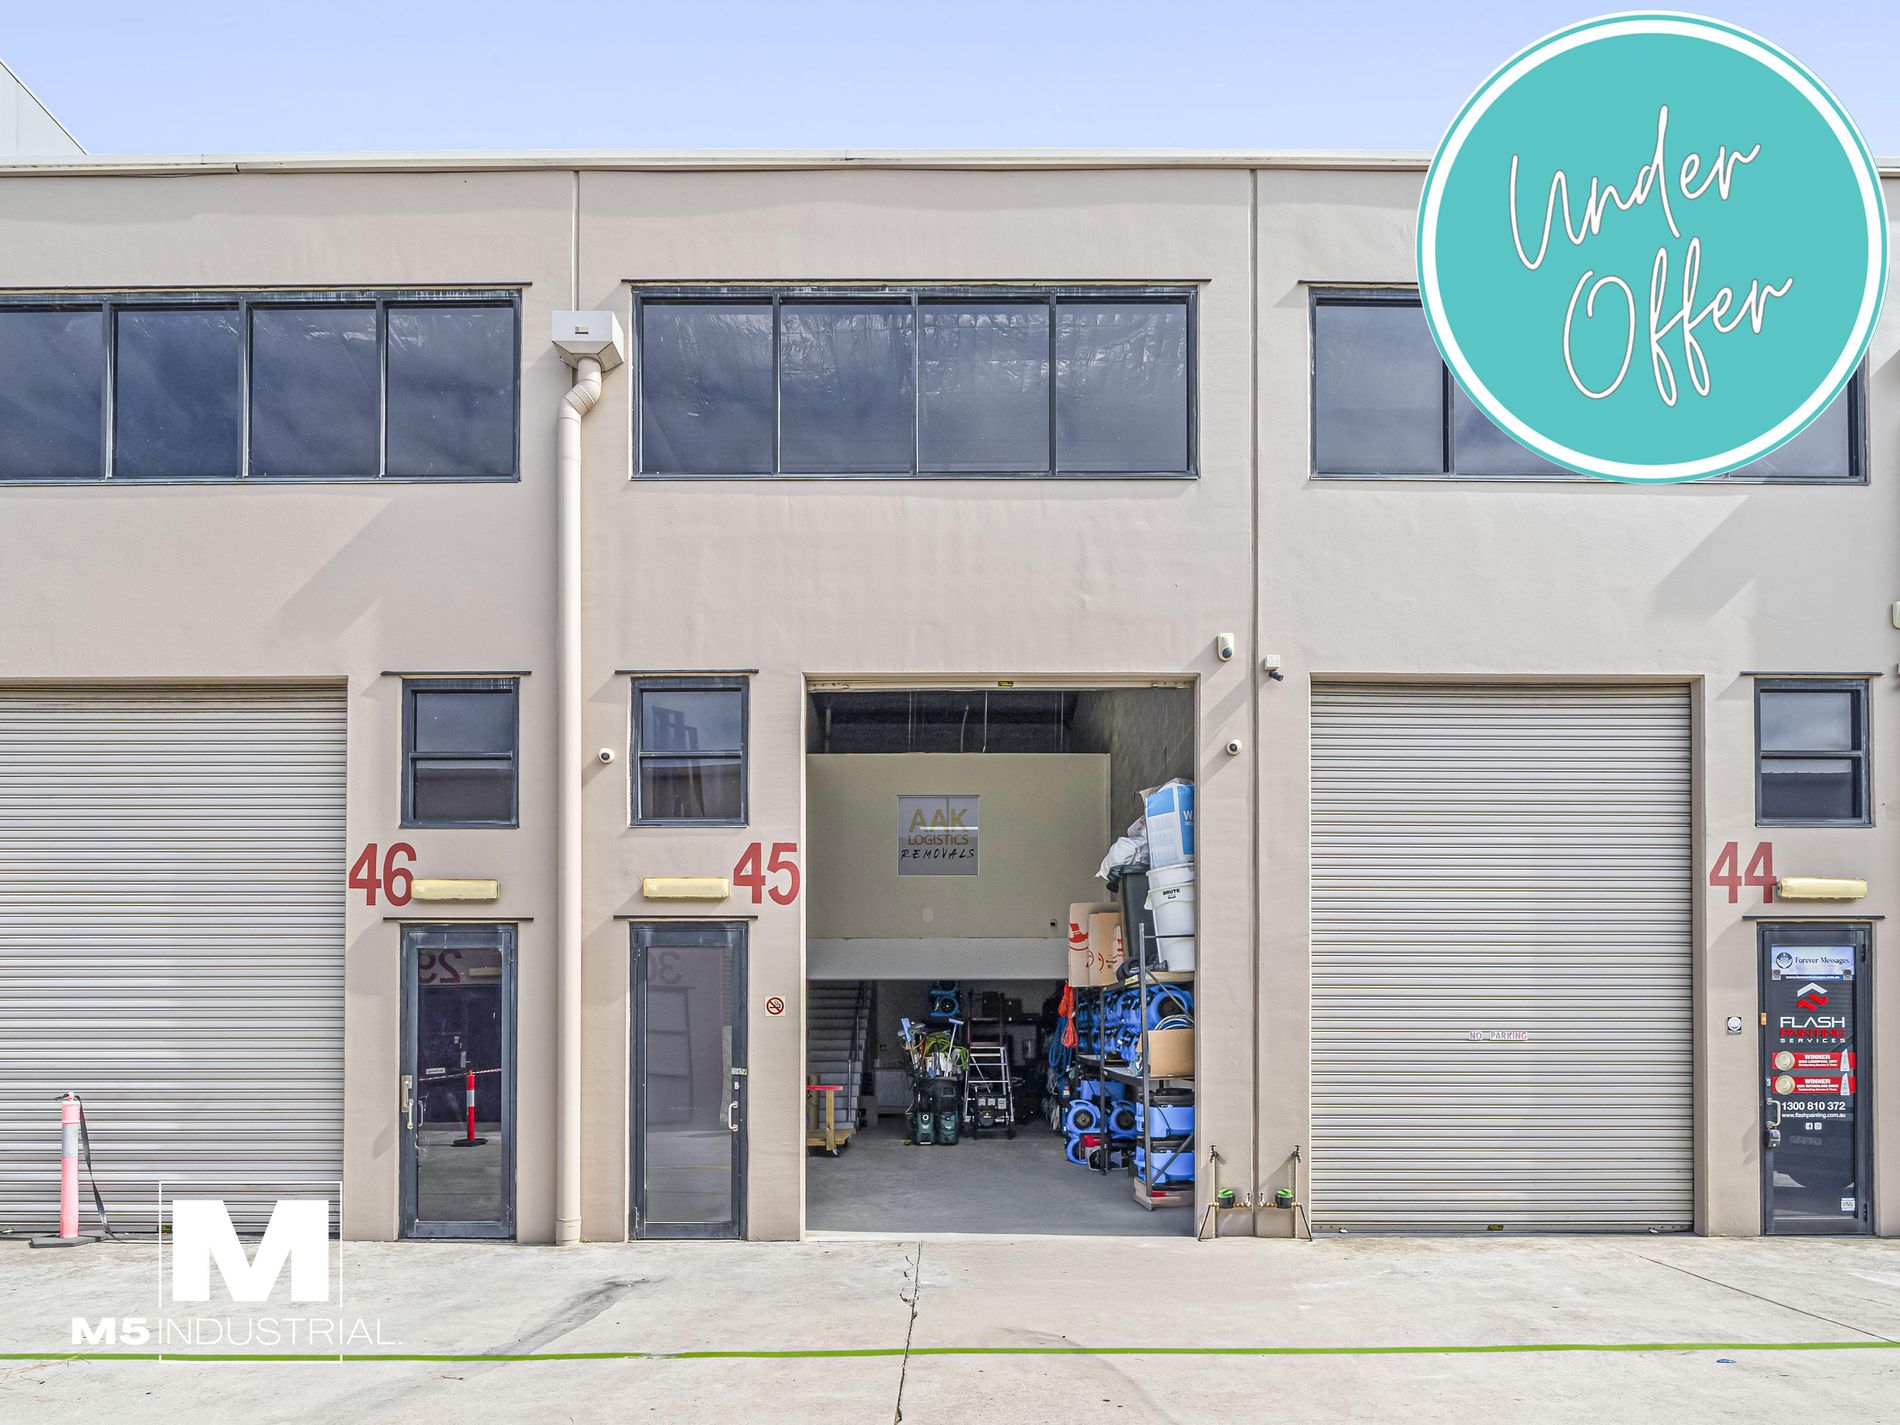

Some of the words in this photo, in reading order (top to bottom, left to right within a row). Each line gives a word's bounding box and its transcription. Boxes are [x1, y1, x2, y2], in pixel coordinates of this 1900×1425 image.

[908, 808, 968, 832] AAK
[908, 834, 969, 845] LOGISTICS
[900, 848, 975, 860] REMOVALS
[348, 843, 418, 906] 46
[733, 842, 801, 905] 45
[1709, 842, 1777, 903] 44
[1795, 956, 1818, 964] Forever
[1820, 956, 1850, 965] Messages
[1780, 1016, 1845, 1028] FLASH
[1469, 1031, 1482, 1040] NO
[1489, 1031, 1528, 1040] PARKING
[1780, 1028, 1845, 1037] PAINTING
[1782, 1102, 1805, 1111] 1300
[1807, 1102, 1826, 1111] 810
[1827, 1102, 1846, 1111] 372
